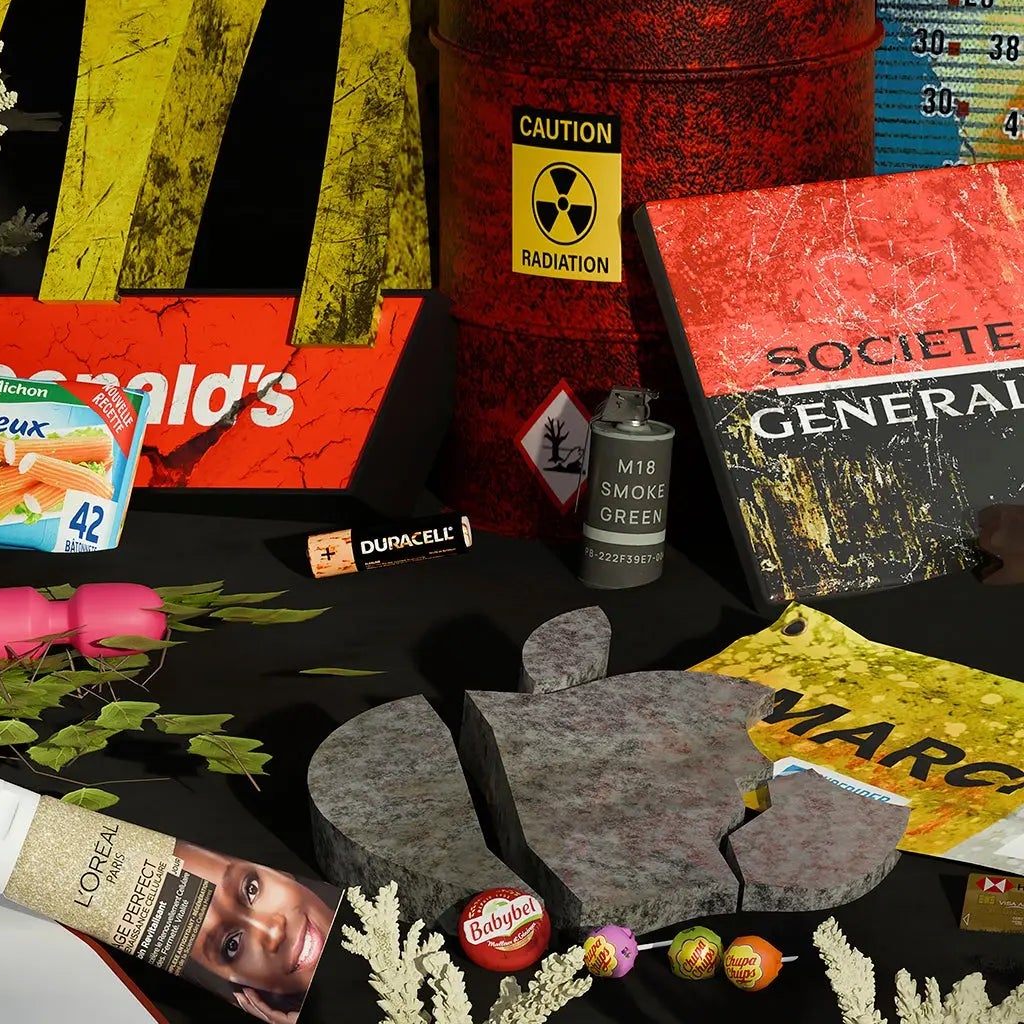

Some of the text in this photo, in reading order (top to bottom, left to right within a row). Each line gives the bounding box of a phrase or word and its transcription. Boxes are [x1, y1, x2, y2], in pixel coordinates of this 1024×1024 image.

[912, 28, 945, 56] 30
[990, 35, 1020, 61] 38
[923, 87, 953, 115] 30
[519, 116, 612, 144] CAUTION
[522, 249, 609, 273] RADIATION
[766, 322, 1022, 377] SOCIETE
[92, 393, 124, 433] RECETTE
[103, 384, 133, 427] NOUVELLE
[618, 459, 655, 475] M18
[601, 482, 665, 500] SMOKE
[69, 501, 104, 543] 42
[600, 507, 662, 524] GREEN
[762, 687, 1024, 796] MARC
[74, 825, 119, 908] L'ORÉAL
[106, 853, 125, 884] PARIS
[119, 858, 160, 925] PERFECT
[124, 861, 169, 954] ENAISSANCE CELLULAIRE
[174, 899, 191, 924] Vitalité
[470, 898, 536, 941] Babybel
[137, 900, 168, 960] oin Revitalisant
[683, 940, 706, 972] Chupa
[691, 948, 717, 978] Chups
[726, 954, 757, 967] Chupa
[726, 967, 755, 984] Chups
